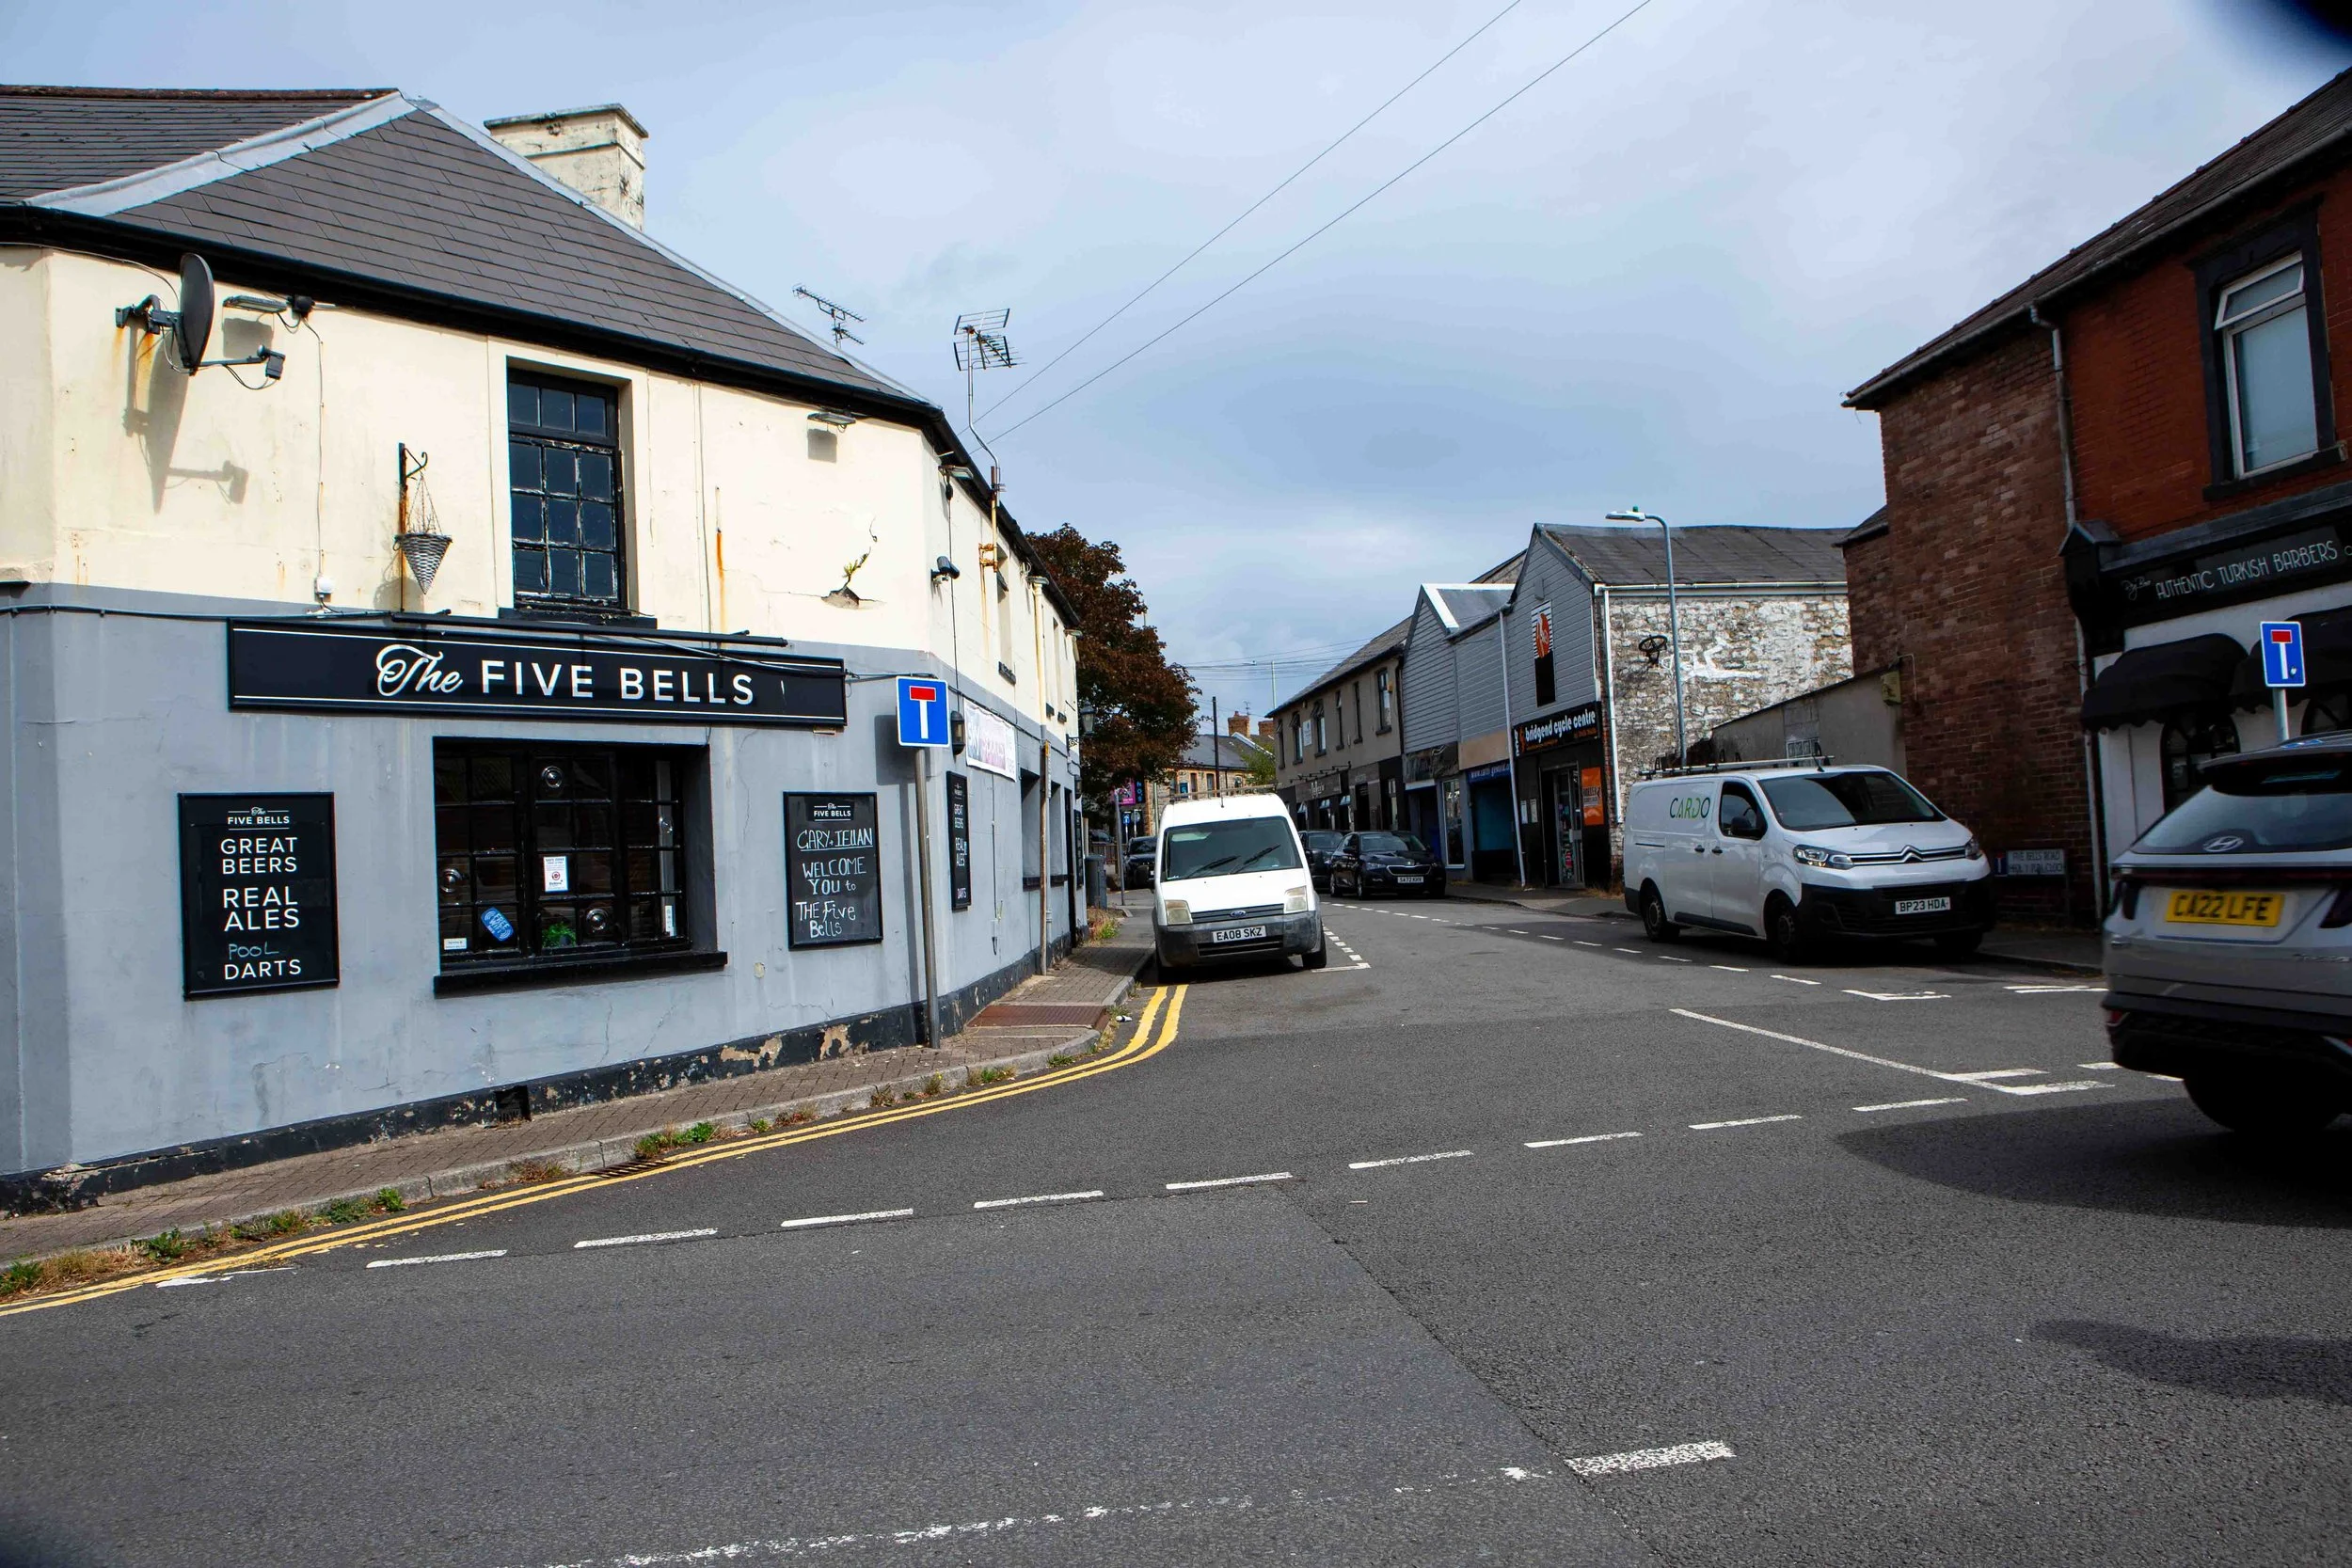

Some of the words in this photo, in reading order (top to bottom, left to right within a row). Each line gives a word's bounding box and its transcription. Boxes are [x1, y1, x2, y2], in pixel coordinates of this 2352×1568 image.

[2154, 570, 2214, 600] AUTHENTIC
[2217, 557, 2270, 586] TURKISH
[2273, 540, 2338, 573] BARBERS
[376, 643, 463, 697] The
[481, 659, 593, 699] FIVE
[619, 668, 755, 705] BELLS
[1525, 720, 1552, 744] bridgend
[1553, 715, 1572, 738] cycle
[1573, 708, 1596, 728] centre
[1669, 797, 1710, 819] CARDO
[228, 816, 252, 825] FIVE
[257, 816, 290, 824] BELLS
[220, 837, 297, 855] GREAT
[222, 857, 296, 875] BEERS
[803, 857, 866, 879] WELCOME
[223, 886, 298, 908] REAL
[808, 879, 840, 895] YOU
[845, 880, 856, 891] to
[796, 901, 820, 921] THE
[822, 900, 856, 924] Five
[1899, 900, 1925, 913] BP23
[1927, 898, 1947, 911] HDA
[2173, 895, 2223, 918] CA22
[2226, 896, 2273, 921] LFE
[224, 908, 299, 931] ALES
[493, 912, 511, 929] FREE
[810, 921, 842, 939] Bells
[1216, 928, 1242, 942] EA08
[1243, 927, 1263, 939] SKZ
[229, 942, 279, 959] POOL
[224, 959, 301, 980] DARTS
